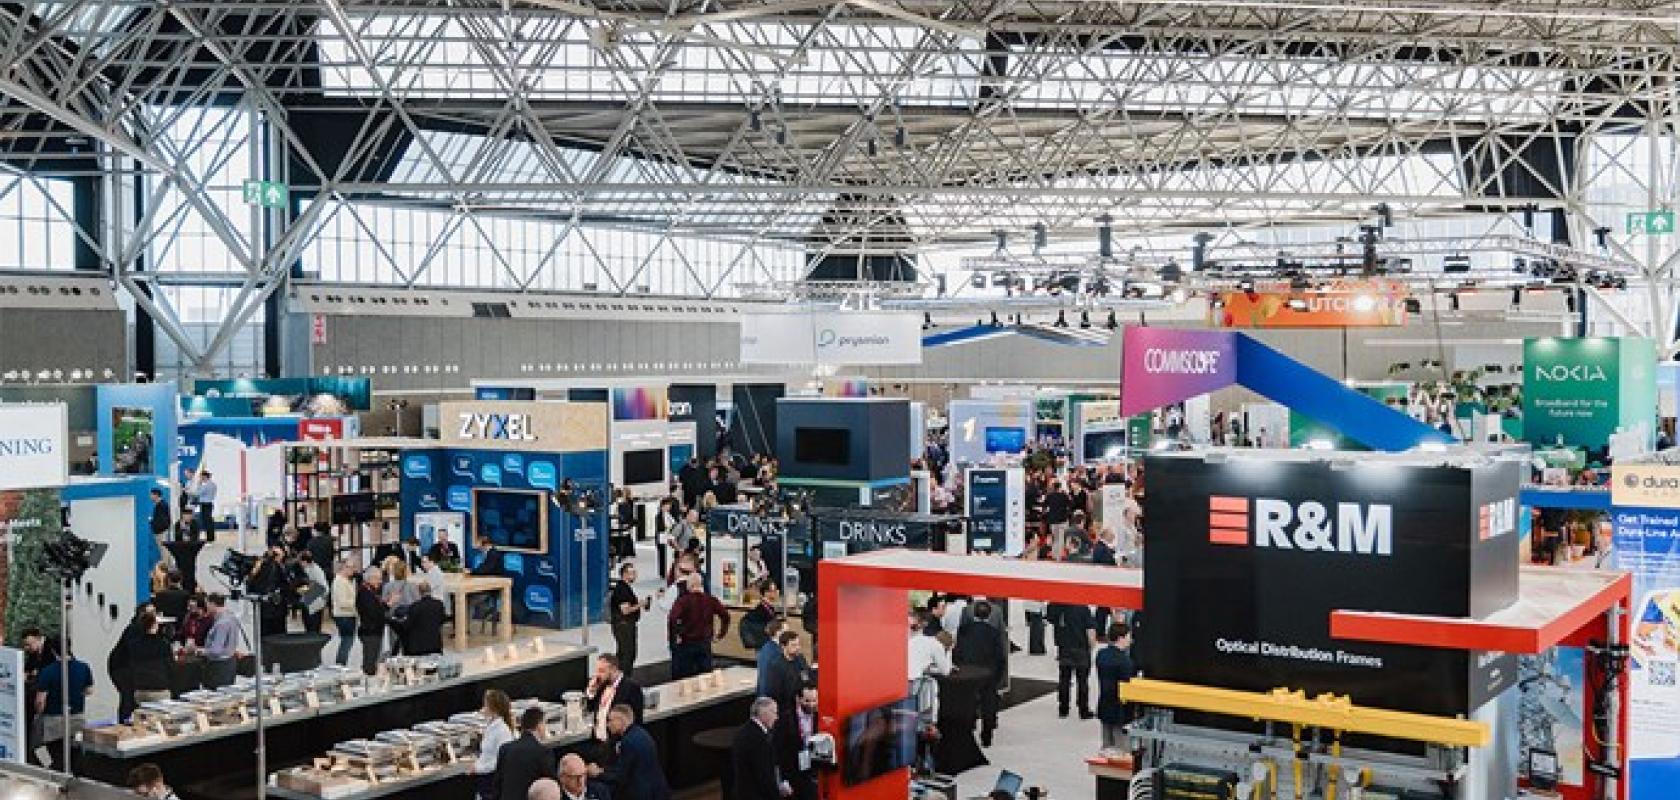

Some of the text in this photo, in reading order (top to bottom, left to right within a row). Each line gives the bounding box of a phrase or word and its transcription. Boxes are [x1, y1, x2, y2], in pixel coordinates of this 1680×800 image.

[840, 292, 881, 312] ZTE
[838, 334, 890, 348] prysmian
[1144, 348, 1220, 374] COMMSCOPE
[1535, 365, 1607, 381] NOKIA
[1535, 399, 1578, 408] Broadband
[1594, 399, 1607, 408] the
[1548, 410, 1574, 418] future
[459, 412, 534, 440] ZYXEL
[0, 438, 52, 456] NING
[839, 521, 907, 545] DRINKS
[1255, 498, 1393, 556] R&M
[1215, 637, 1383, 669] Optical Distribution Frames
